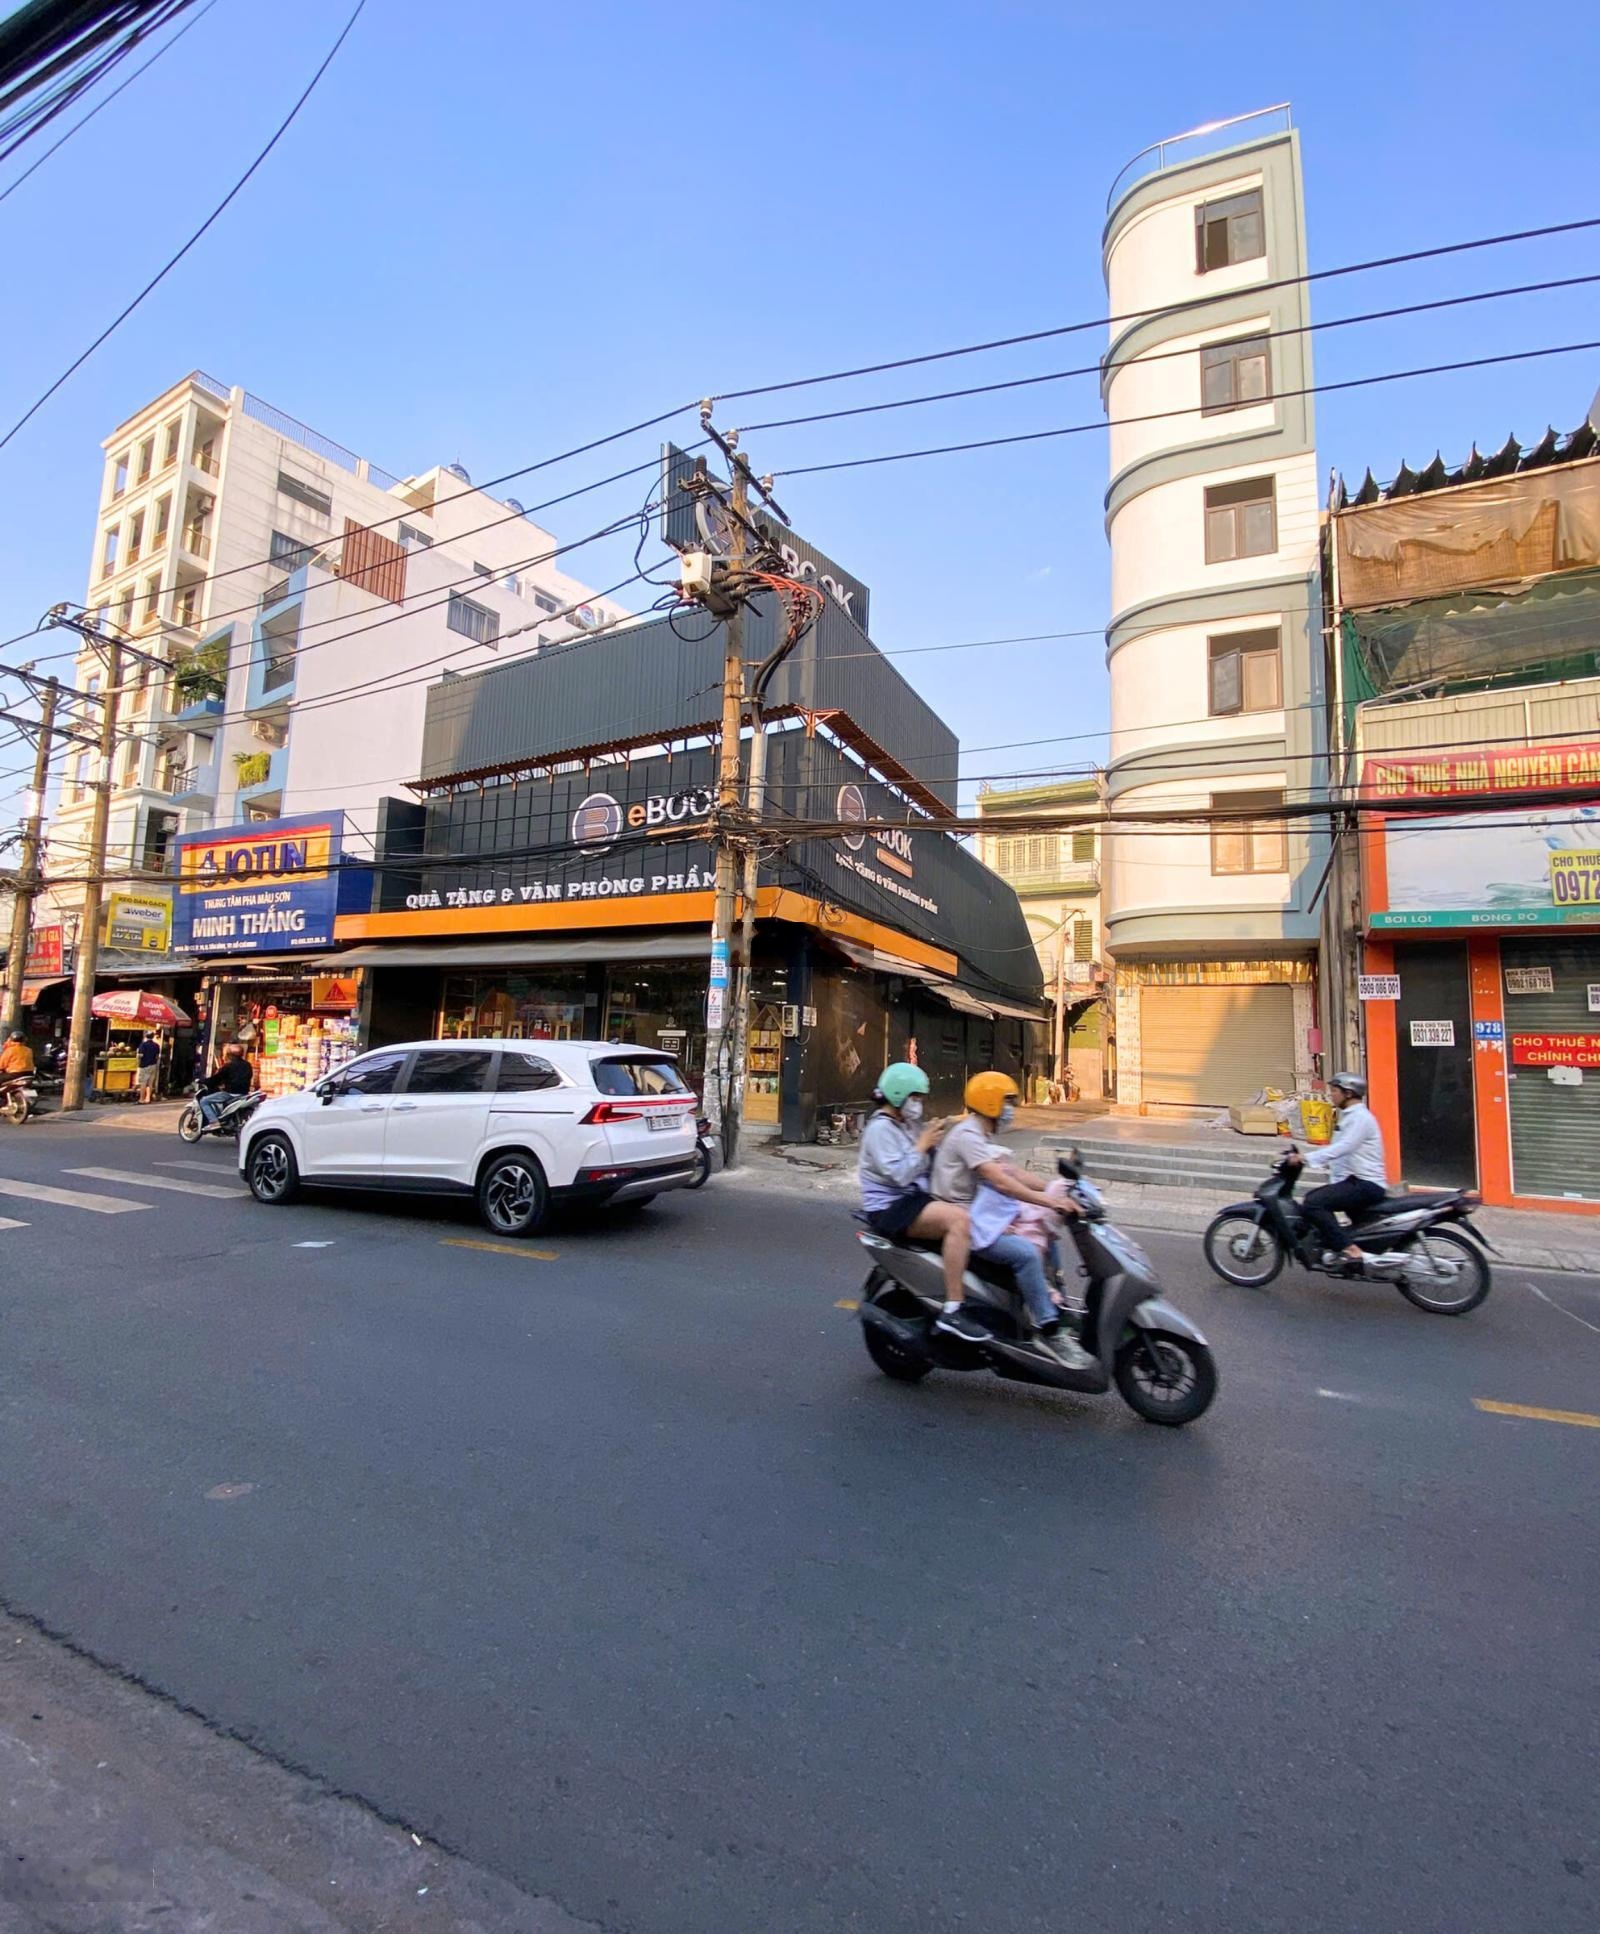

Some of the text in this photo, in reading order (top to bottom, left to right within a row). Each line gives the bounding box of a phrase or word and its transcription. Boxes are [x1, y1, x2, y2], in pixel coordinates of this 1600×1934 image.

[1376, 766, 1407, 796] CHO
[1411, 757, 1452, 794] THUÊ
[1456, 754, 1490, 791] NHÀ
[1494, 749, 1562, 789] NGUYÊN
[627, 785, 719, 827] eBOO
[220, 839, 307, 885] JOTUN
[1552, 856, 1574, 868] CHO
[406, 864, 718, 909] QUÀ TẶNG & VĂN PHÒNG PHẨM
[204, 898, 226, 910] TRUNG
[226, 895, 243, 908] TÂM
[242, 894, 257, 906] PHA
[257, 891, 274, 904] MÀU
[131, 908, 162, 919] weber
[192, 904, 306, 939] MINH THẮNG
[1475, 1022, 1502, 1034] 978
[1512, 1037, 1543, 1047] CHO
[1547, 1035, 1587, 1047] THUÊ
[1527, 1050, 1572, 1062] CHÍNH
